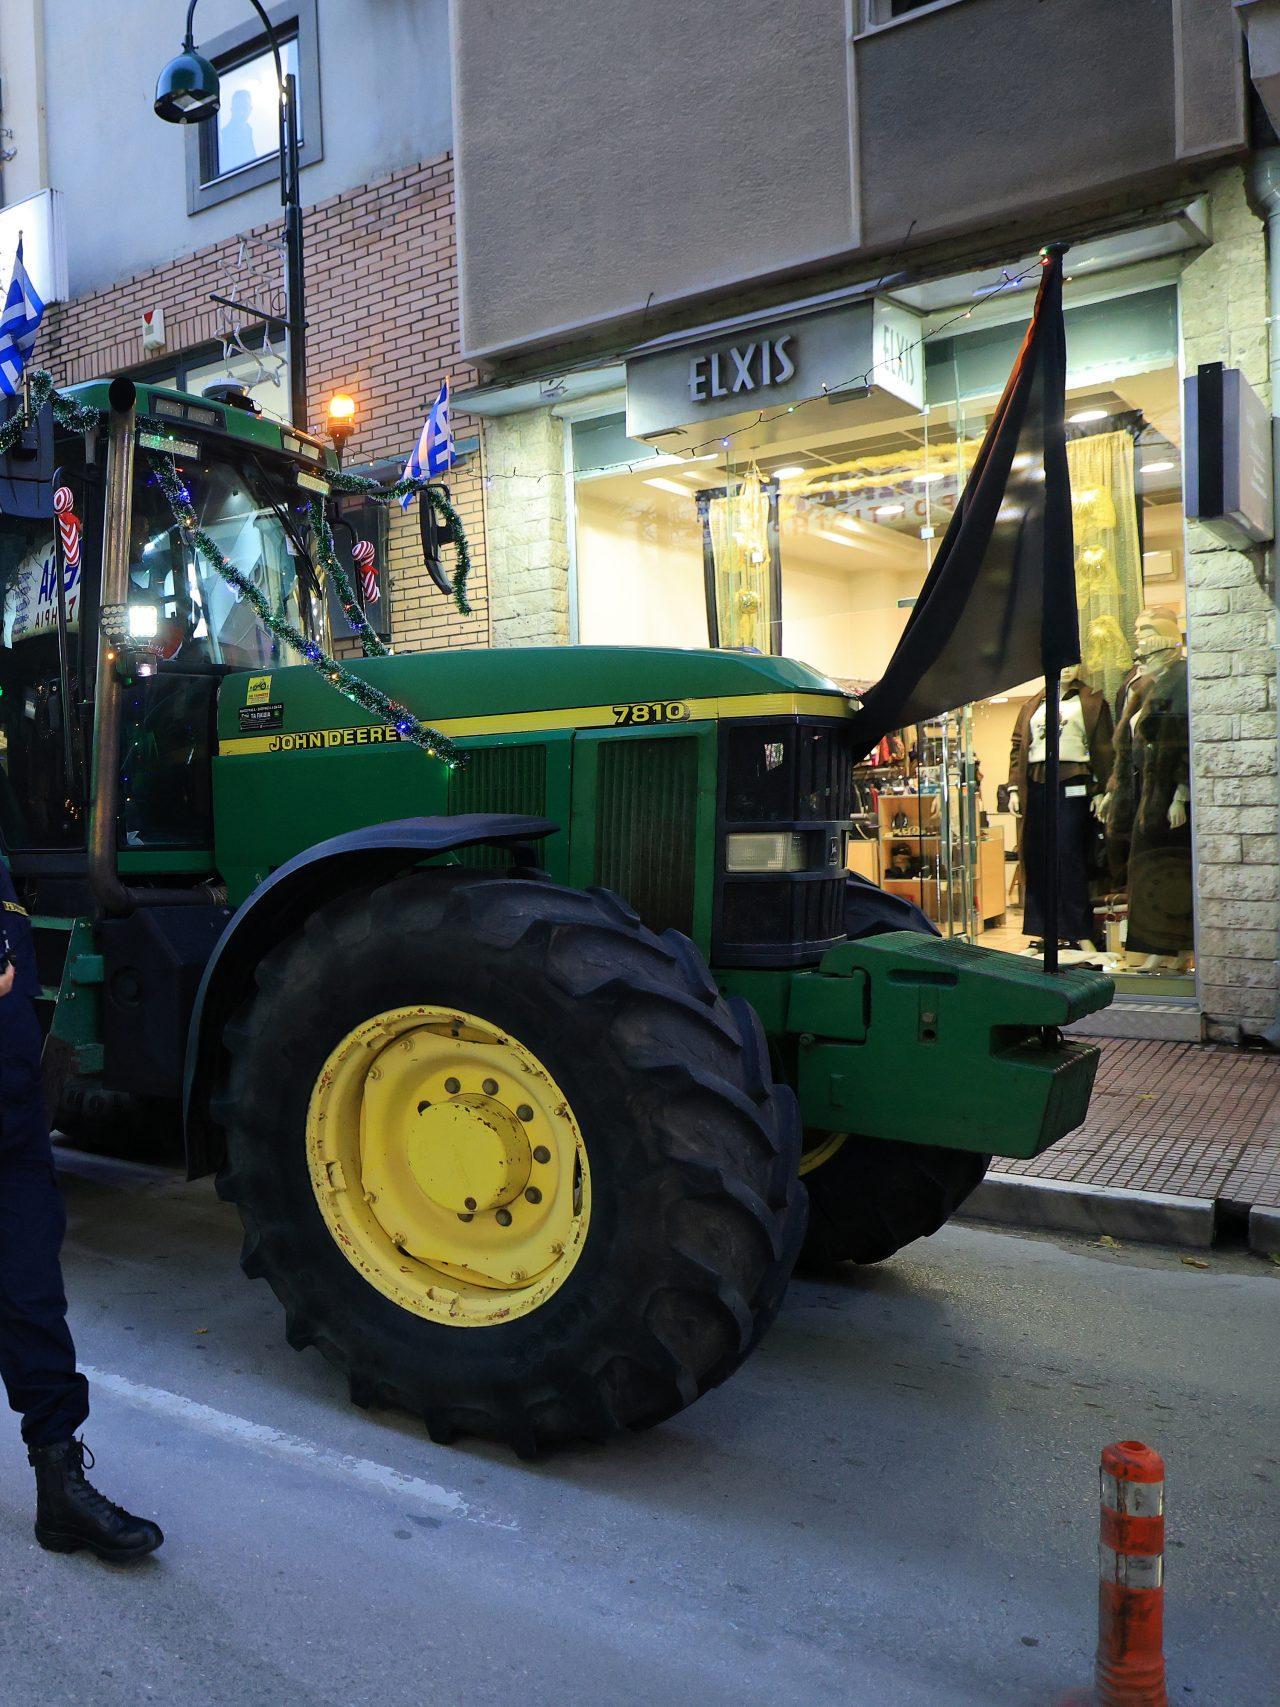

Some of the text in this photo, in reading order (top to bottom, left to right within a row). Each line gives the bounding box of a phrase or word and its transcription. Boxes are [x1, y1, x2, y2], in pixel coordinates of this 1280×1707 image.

[688, 334, 795, 403] ELXIS
[883, 324, 914, 386] ELXIS
[613, 702, 690, 726] 7810
[269, 724, 399, 751] JOHN DEERE
